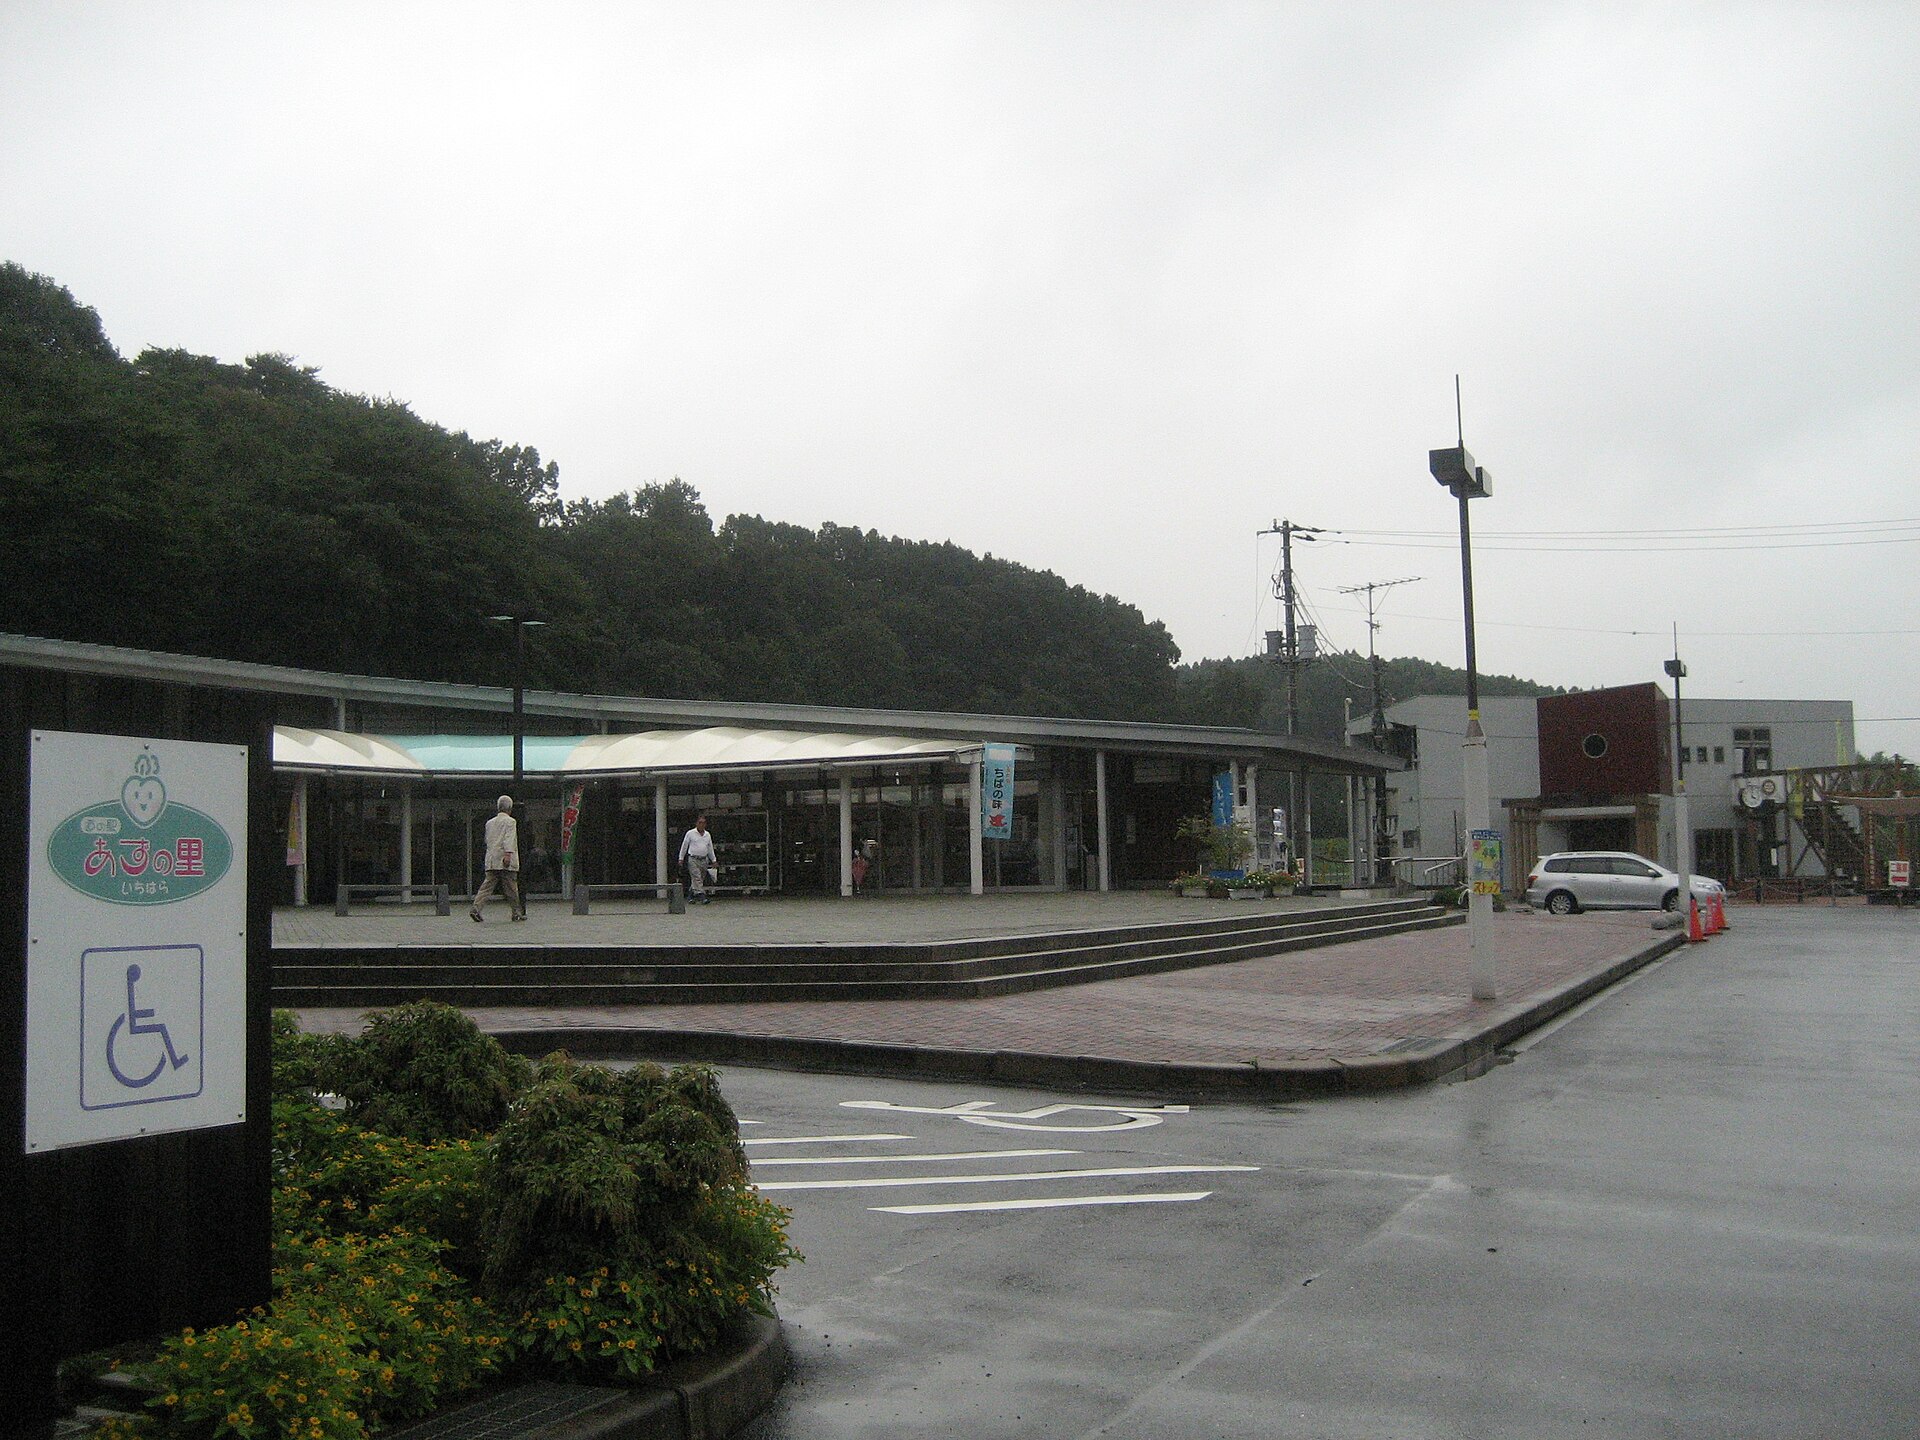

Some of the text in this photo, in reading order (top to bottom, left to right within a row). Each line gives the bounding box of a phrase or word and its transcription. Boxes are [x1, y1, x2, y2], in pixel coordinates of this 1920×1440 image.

[84, 837, 205, 877] あずの里
[121, 881, 169, 895] いちはら
